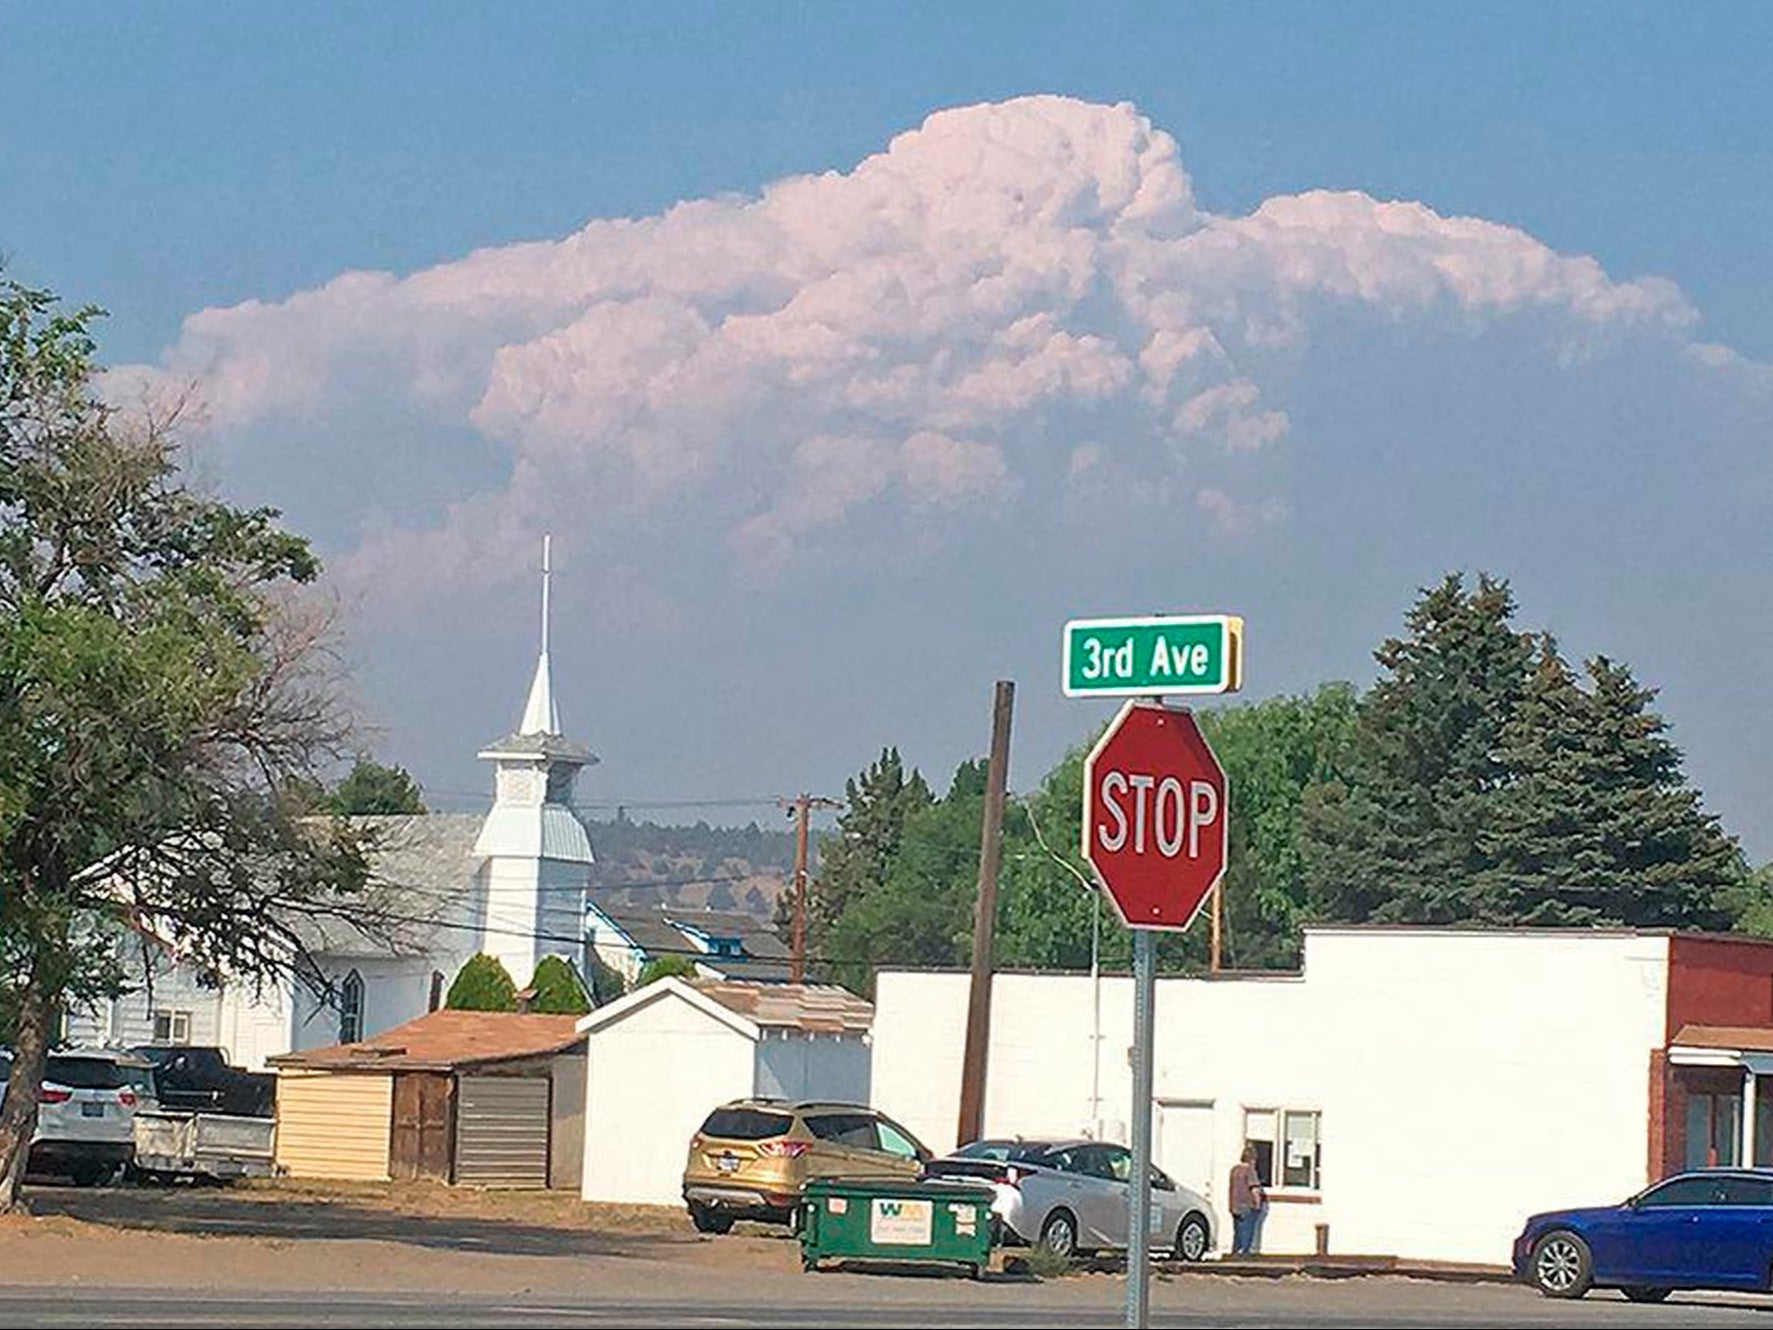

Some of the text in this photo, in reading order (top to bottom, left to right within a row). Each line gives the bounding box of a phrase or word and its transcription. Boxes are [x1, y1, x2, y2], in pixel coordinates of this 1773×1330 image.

[1082, 635, 1209, 679] 3rd Ave
[1098, 771, 1218, 858] STOP
